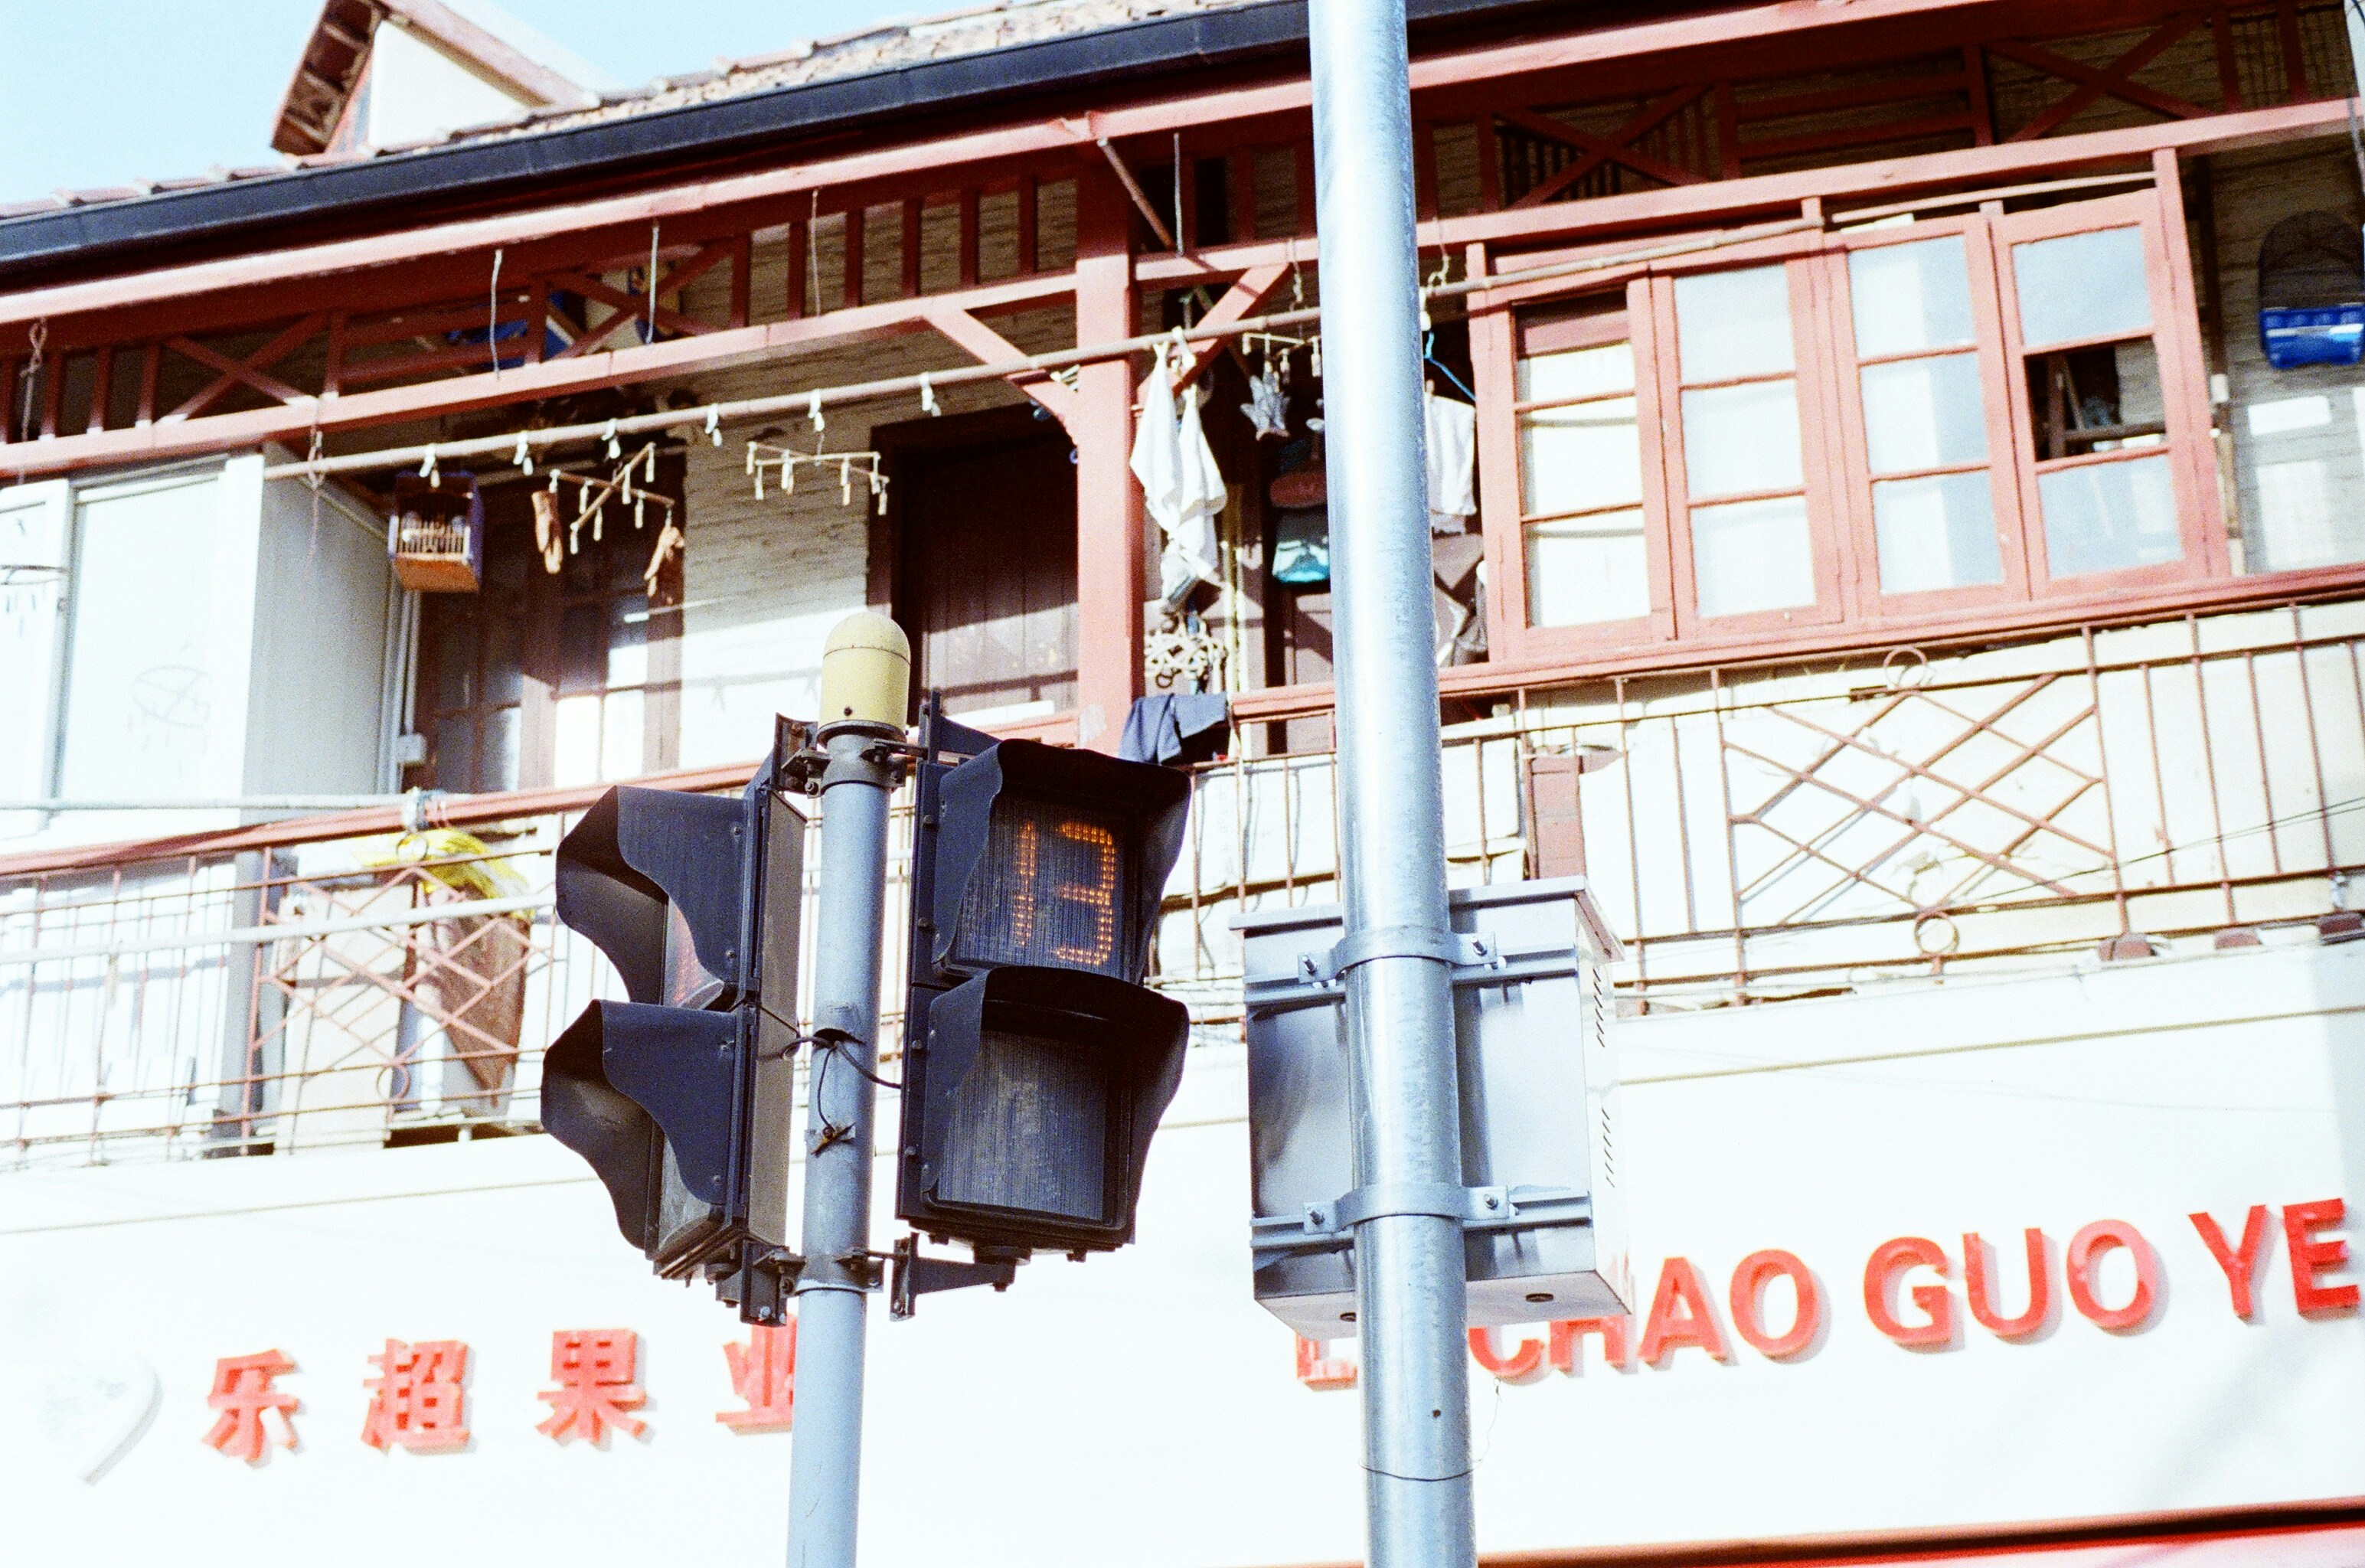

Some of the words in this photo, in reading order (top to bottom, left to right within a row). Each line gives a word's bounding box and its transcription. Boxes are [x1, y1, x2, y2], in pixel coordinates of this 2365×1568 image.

[1013, 819, 1116, 966] 13
[1862, 1219, 2159, 1351] GUO
[2187, 1197, 2363, 1321] YE
[201, 1312, 799, 1461] 乐超果业
